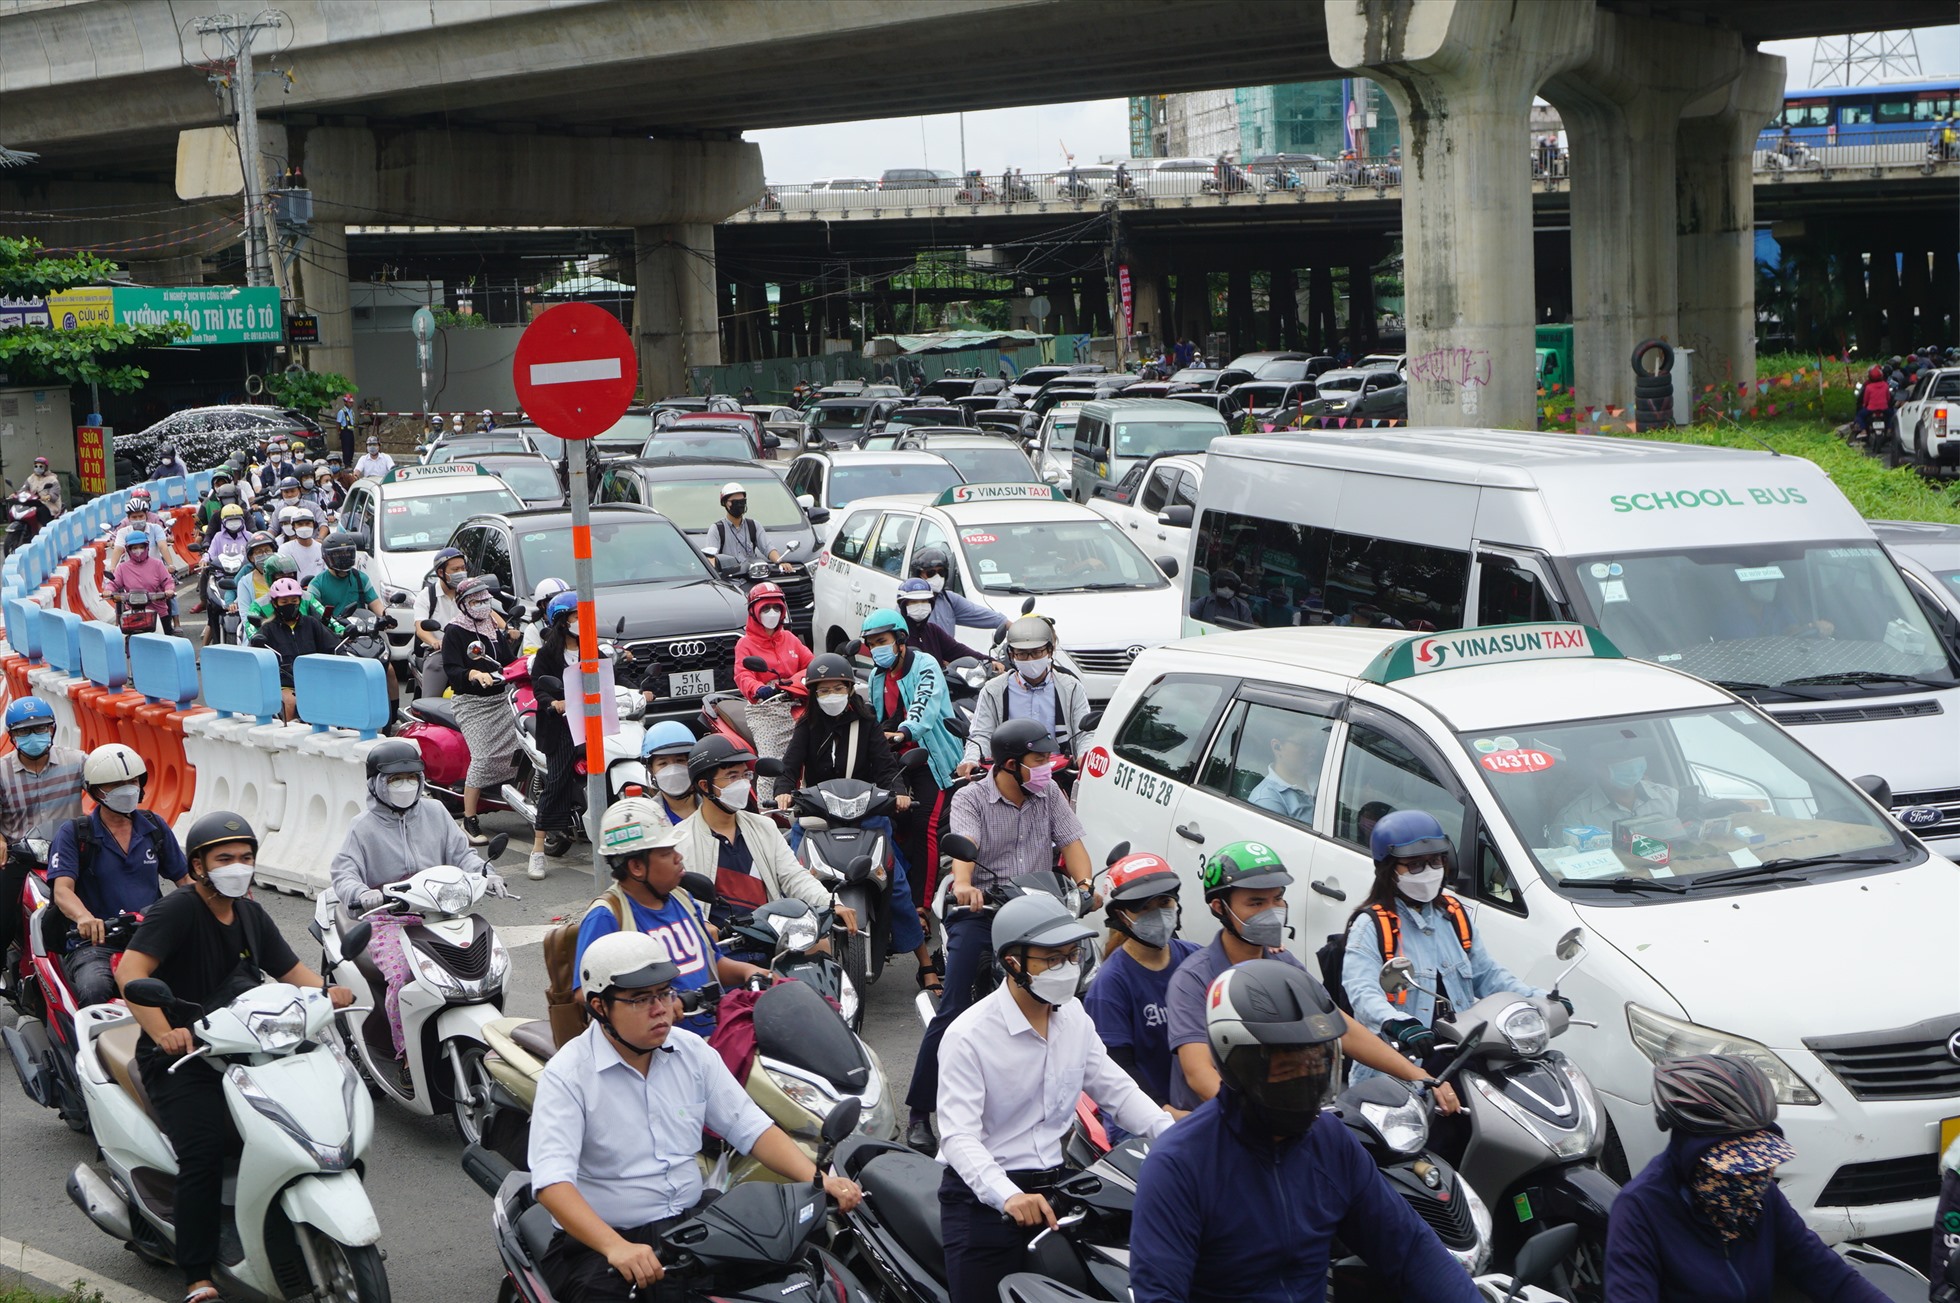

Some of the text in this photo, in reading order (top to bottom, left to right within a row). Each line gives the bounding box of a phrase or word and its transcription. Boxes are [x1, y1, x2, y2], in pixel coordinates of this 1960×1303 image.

[78, 306, 110, 321] CỨU HỘ
[203, 304, 224, 331] TRÌ
[227, 308, 244, 330] XE
[247, 303, 255, 329] Ô
[258, 303, 274, 329] TÔ
[82, 429, 99, 444] SỬA
[84, 460, 101, 474] Ô TÔ
[81, 475, 106, 493] XE MÁY
[978, 487, 1050, 497] VINASUN TAXI
[1610, 487, 1808, 513] SCHOOL BUS
[682, 673, 702, 685] 51K
[675, 683, 711, 696] 267.60
[1087, 751, 1109, 775] 14370
[1484, 753, 1547, 770] 14370
[1114, 762, 1174, 807] 51F 135 28
[1910, 810, 1935, 823] Ford
[781, 1281, 811, 1296] HONDA
